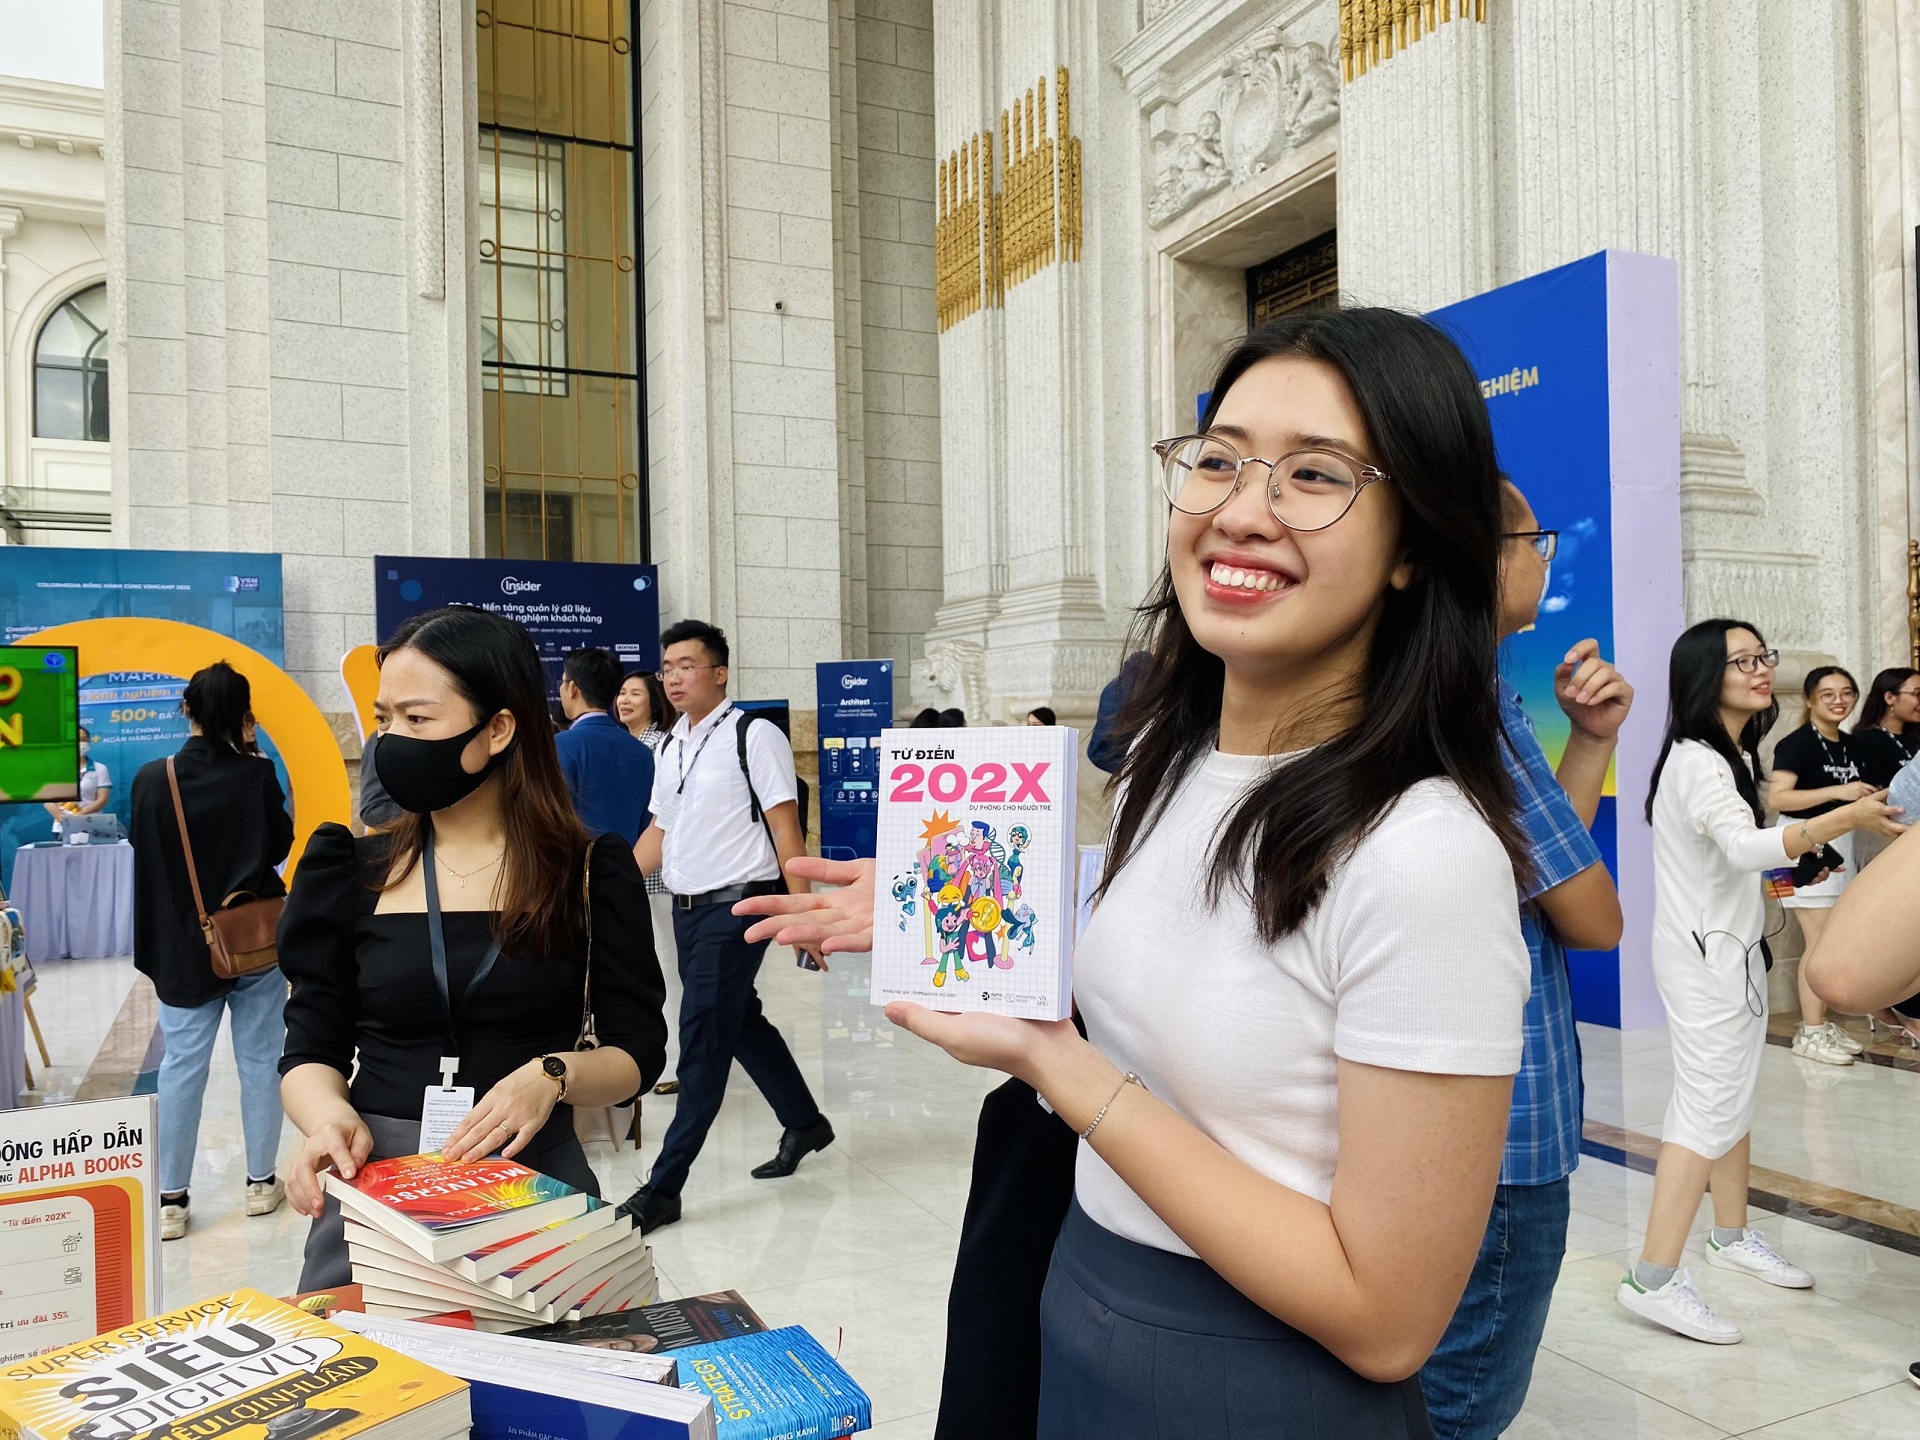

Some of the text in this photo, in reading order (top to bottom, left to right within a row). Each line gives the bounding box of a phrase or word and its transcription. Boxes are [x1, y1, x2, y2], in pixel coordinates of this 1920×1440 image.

[1479, 365, 1539, 399] GHIỆM
[502, 578, 542, 592] Insider
[503, 603, 524, 613] tảng
[551, 614, 578, 622] khách
[580, 614, 602, 625] hàng
[110, 707, 157, 724] 500+
[840, 698, 870, 706] Architect
[891, 744, 955, 760] TỪ ĐIỂN
[889, 762, 1052, 803] 202X
[0, 1121, 143, 1167] ỘNG HẤP DẪN
[18, 1161, 76, 1184] ALPHA
[84, 1152, 143, 1175] BOOKS
[382, 1167, 530, 1204] METAVERSE
[52, 1310, 69, 1321] 35%
[640, 1303, 694, 1338] MUSK
[6, 1297, 243, 1382] SUPER SERVICE
[59, 1322, 276, 1411] SIÊU
[110, 1344, 318, 1432] DỊCH VỤ
[690, 1358, 752, 1420] STRATEGY
[796, 1425, 819, 1438] XANH
